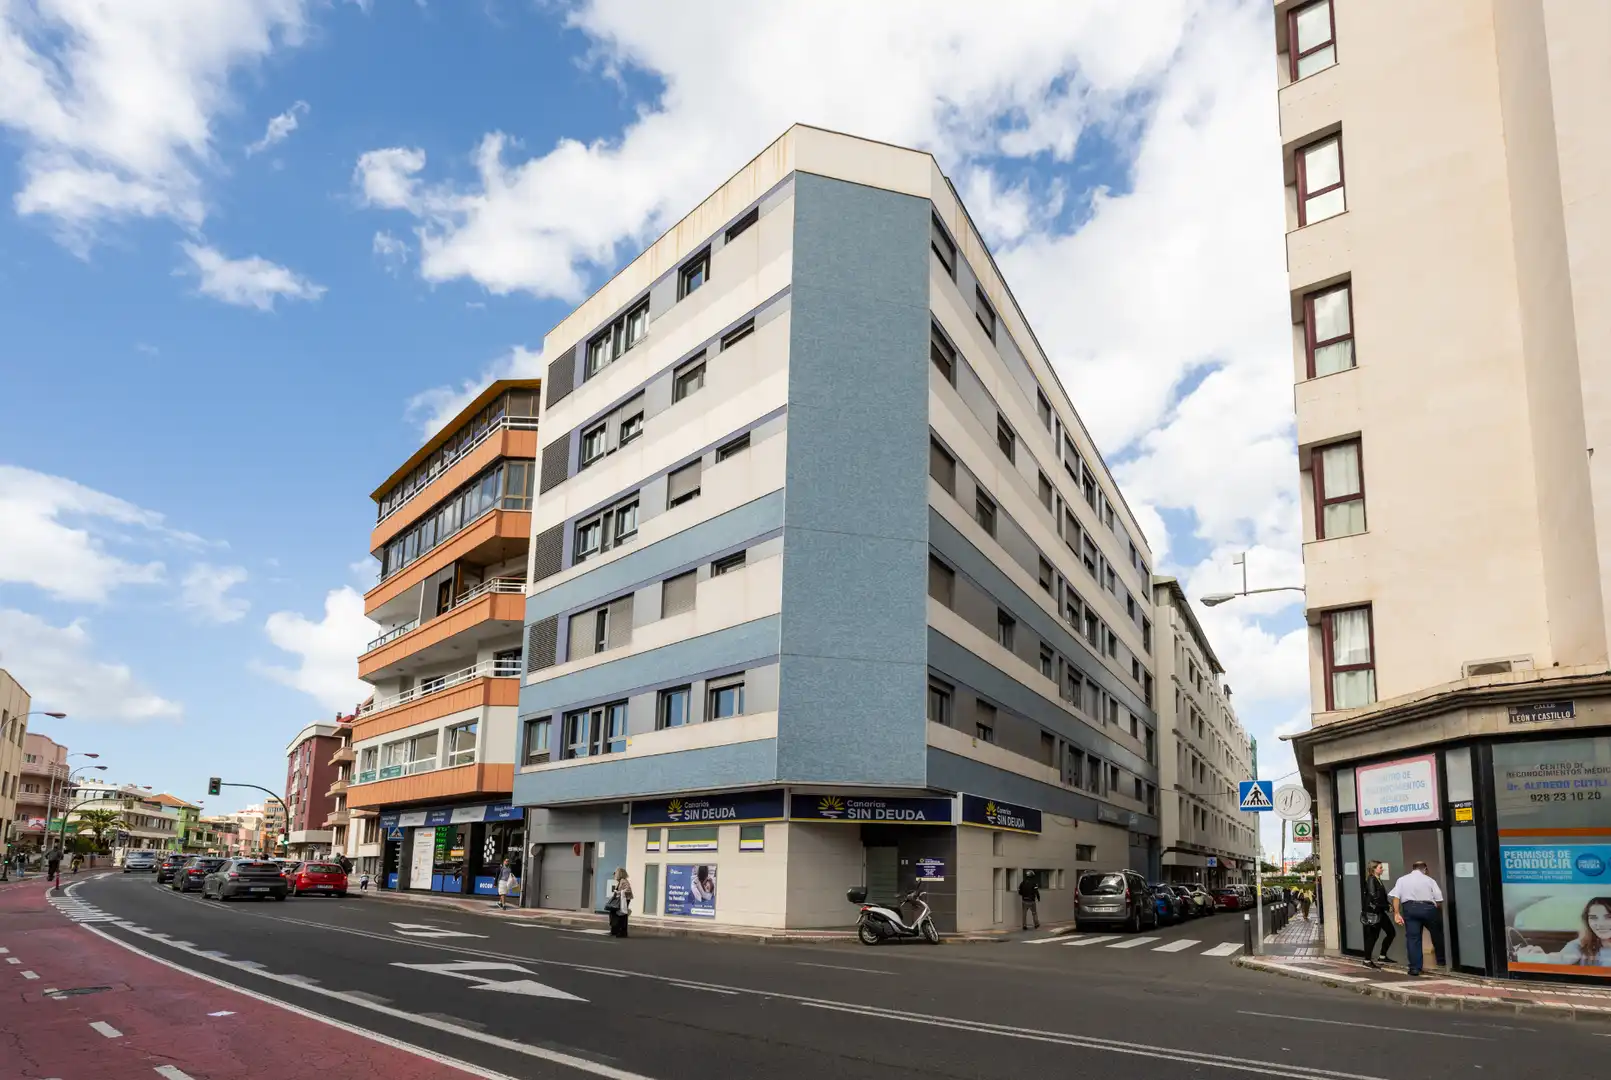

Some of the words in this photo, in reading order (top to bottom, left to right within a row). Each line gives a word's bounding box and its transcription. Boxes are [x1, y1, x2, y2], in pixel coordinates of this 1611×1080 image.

[1512, 713, 1530, 723] LEÓN
[1538, 710, 1571, 720] CASTILLO
[1540, 762, 1572, 771] CENTRO
[1524, 780, 1570, 790] ALFREDO
[1530, 793, 1550, 802] 928
[1553, 793, 1567, 801] 23
[1571, 792, 1584, 801] 10
[1587, 791, 1602, 800] 20
[684, 801, 709, 809] Canarias
[846, 800, 886, 808] Canarias
[1373, 805, 1399, 815] ALFREDO
[1399, 802, 1430, 812] CUTILLAS
[684, 809, 700, 821] SIN
[702, 807, 736, 819] DEUDA
[847, 808, 871, 819] SIN
[875, 809, 926, 820] DEUDA
[997, 814, 1007, 826] SIN
[1007, 816, 1025, 828] DEUDA
[1504, 850, 1555, 859] PERMISOS
[1557, 850, 1572, 859] DE
[1505, 858, 1572, 869] CONDUCIR
